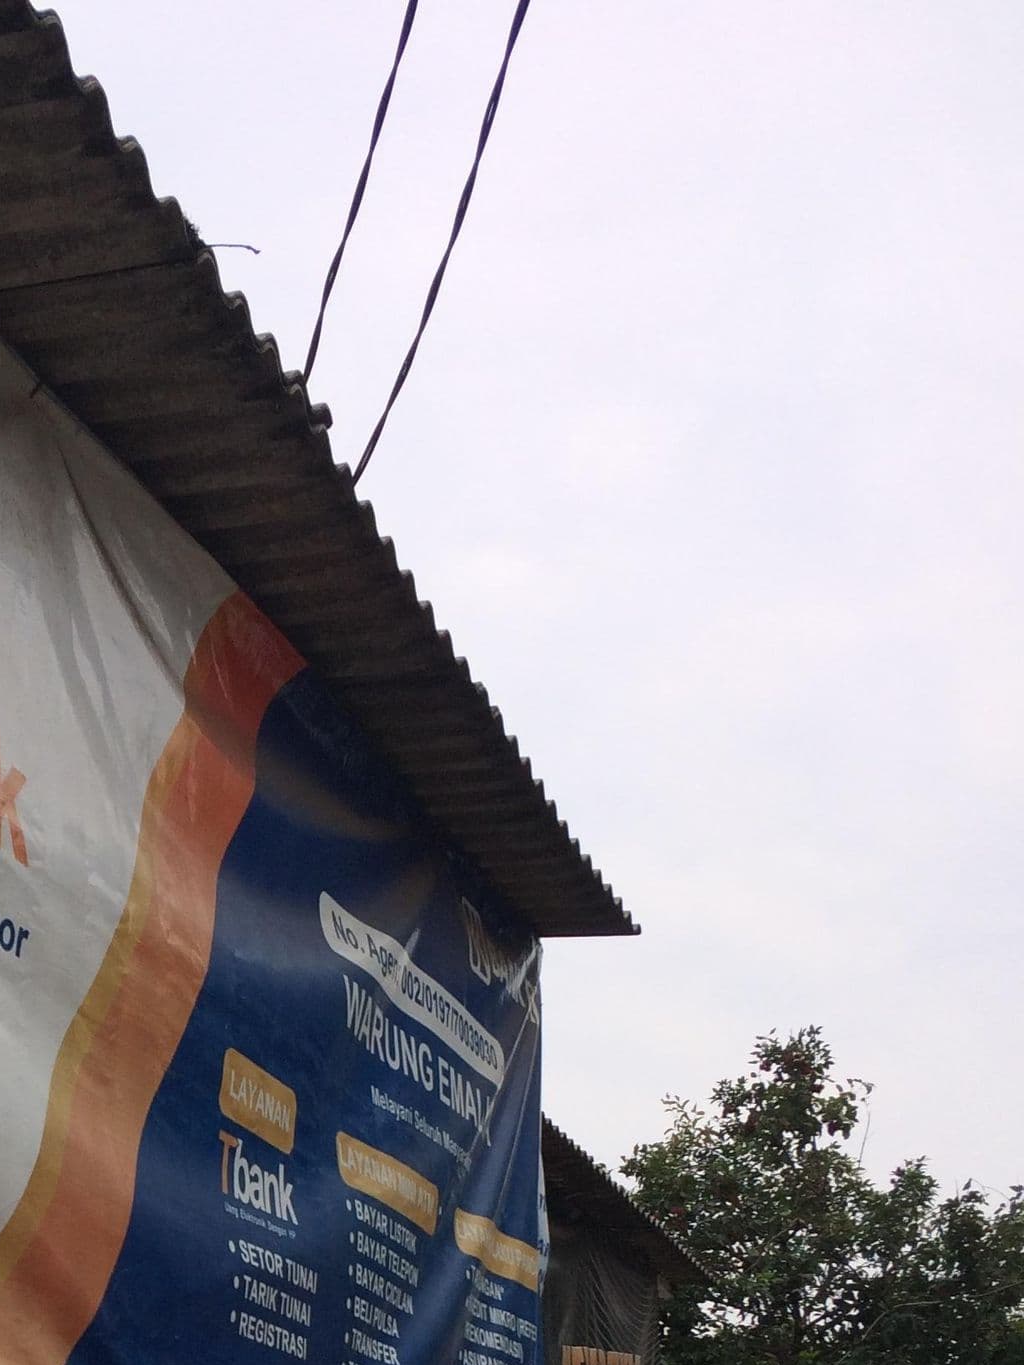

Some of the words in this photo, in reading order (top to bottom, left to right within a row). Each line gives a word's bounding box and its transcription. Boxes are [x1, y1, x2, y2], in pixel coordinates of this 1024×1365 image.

[343, 974, 435, 1092] WARUNG
[229, 1069, 291, 1133] LAYANAN
[354, 1199, 388, 1237] BAYAR
[238, 1239, 284, 1279] SETOR
[285, 1258, 319, 1295] TUNAI
[355, 1262, 385, 1299] BAYAR
[356, 1230, 387, 1268] BAYAR
[387, 1248, 419, 1289] TELEPON
[242, 1274, 278, 1313] TARIK
[279, 1291, 312, 1328] TUNAI
[353, 1295, 373, 1324] BELI
[372, 1306, 400, 1339] PULSA
[238, 1311, 308, 1361] REGISTRASI
